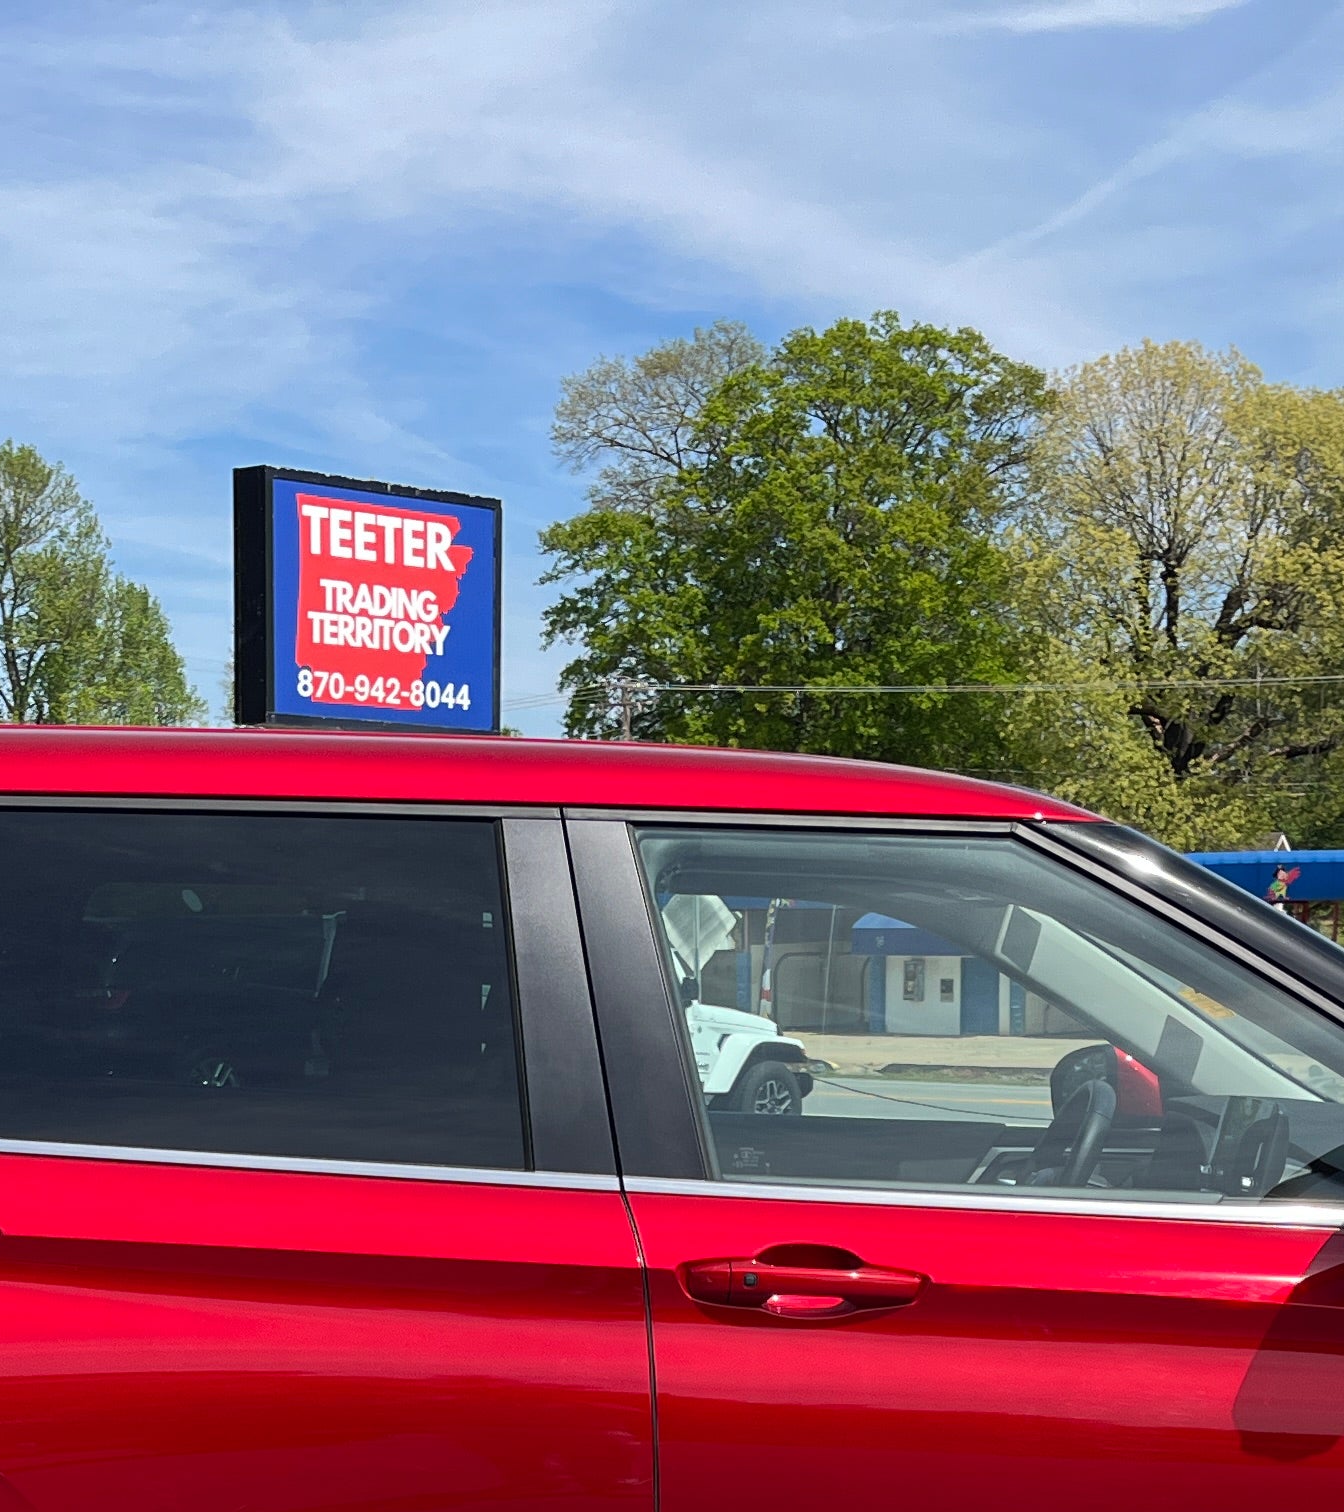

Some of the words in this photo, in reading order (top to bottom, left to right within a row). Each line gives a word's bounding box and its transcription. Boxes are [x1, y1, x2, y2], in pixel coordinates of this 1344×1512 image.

[301, 504, 456, 572] TEETER
[319, 578, 439, 623] TRADING
[307, 611, 451, 656] TERRITORY
[296, 669, 472, 711] 870-942-8044
